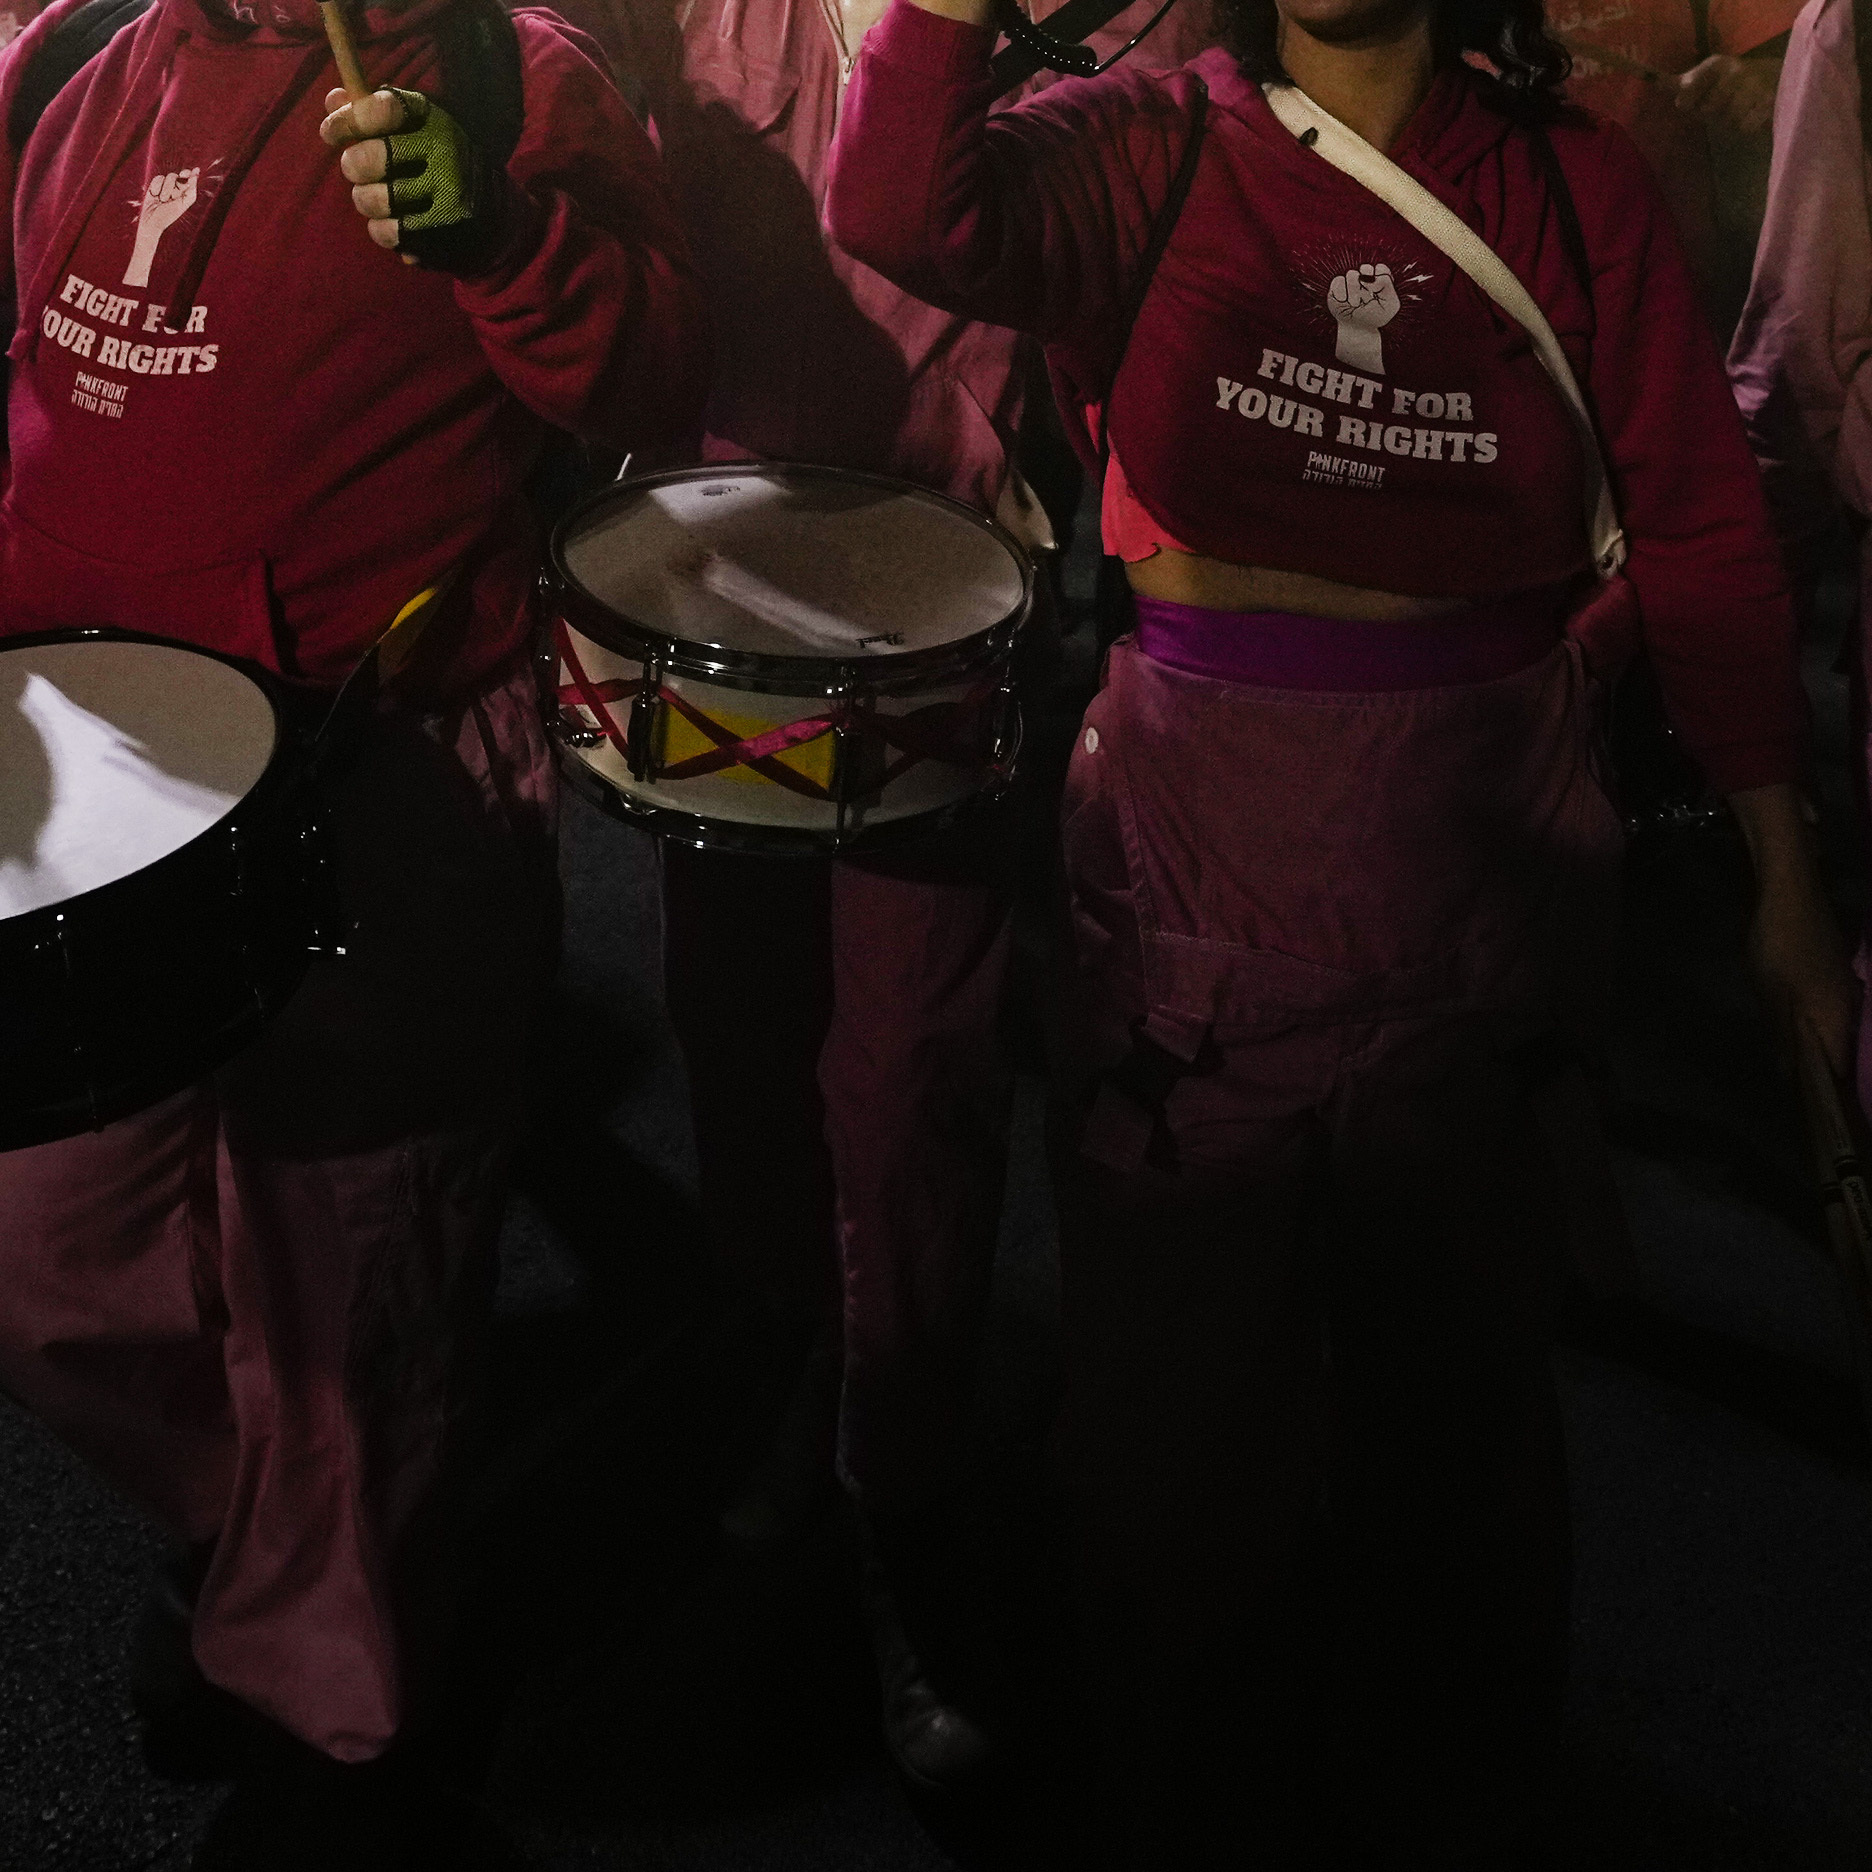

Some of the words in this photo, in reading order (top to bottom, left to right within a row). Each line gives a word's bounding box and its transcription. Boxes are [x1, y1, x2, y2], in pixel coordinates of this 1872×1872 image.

[41, 304, 97, 359] OUR
[97, 335, 220, 376] RIGHTS
[60, 274, 139, 327] FIGHT
[142, 303, 208, 335] FR
[1216, 377, 1324, 438] YOUR
[1336, 415, 1498, 464] RIGHTS
[1257, 348, 1383, 410] FIGHT
[1392, 388, 1473, 421] FOR
